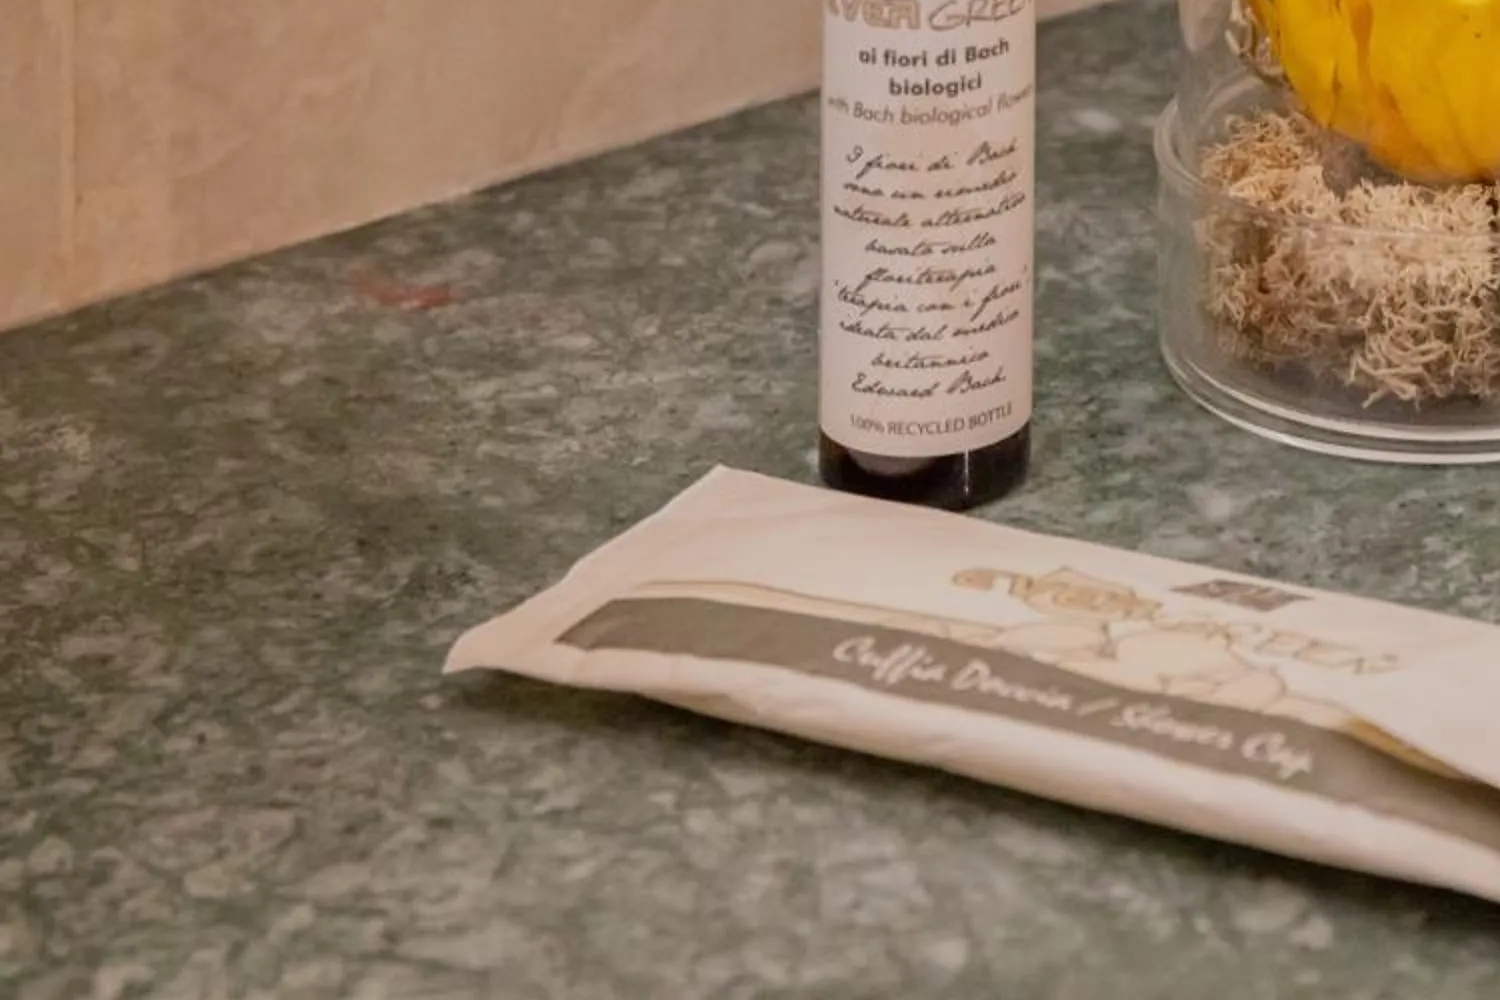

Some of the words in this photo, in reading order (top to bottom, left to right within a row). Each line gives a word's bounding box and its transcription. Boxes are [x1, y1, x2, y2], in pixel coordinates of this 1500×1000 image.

[859, 49, 877, 66] ai
[884, 50, 928, 68] fiori
[936, 50, 957, 68] di
[965, 37, 1010, 63] Bach
[889, 73, 983, 98] biologici
[854, 102, 896, 125] Bach
[900, 98, 994, 127] biological
[928, 150, 956, 172] di
[967, 137, 1019, 166] Bach
[946, 366, 1007, 395] Bach
[850, 414, 886, 436] 100%
[888, 417, 966, 437] RECYCLED
[968, 402, 1014, 431] BOTTLE
[832, 635, 949, 684] Cuffia
